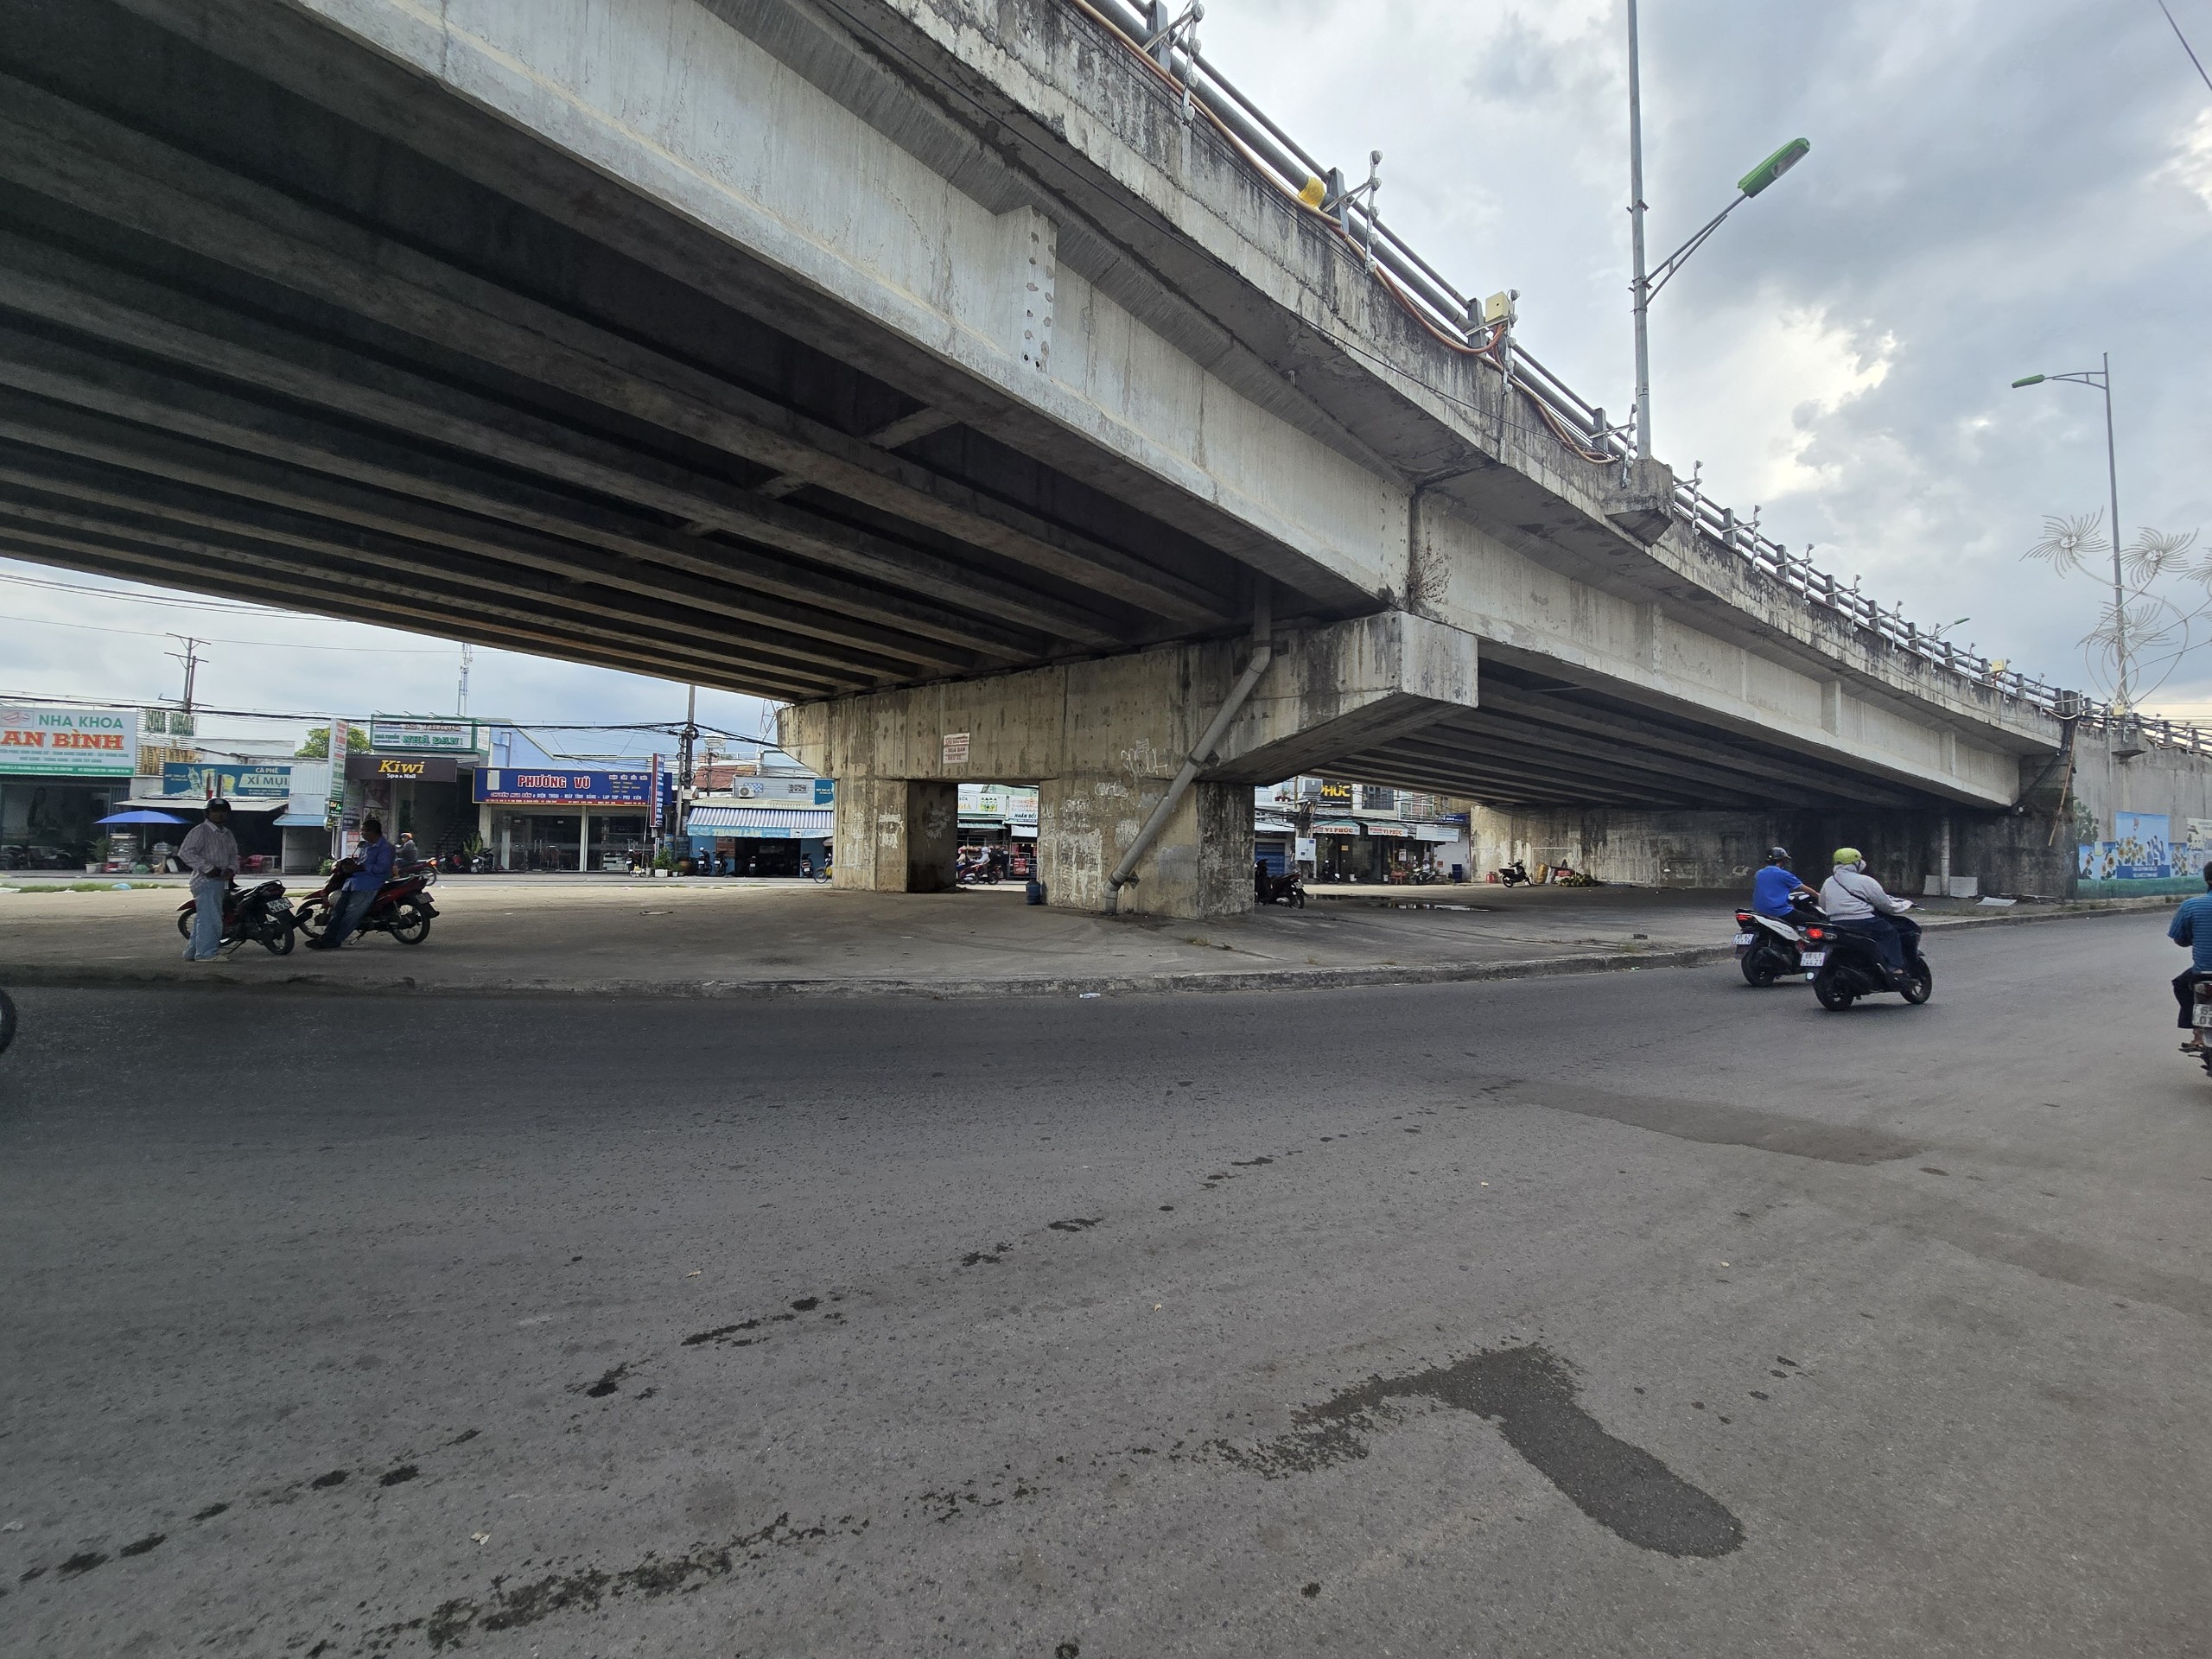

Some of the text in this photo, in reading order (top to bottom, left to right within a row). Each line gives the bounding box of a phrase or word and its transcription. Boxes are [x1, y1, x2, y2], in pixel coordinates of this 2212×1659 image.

[39, 715, 124, 728] NHA KHOA
[1, 728, 124, 750] AN BÌNH
[378, 760, 425, 774] Kiwi
[518, 774, 591, 789] PHƯƠNG VŨ
